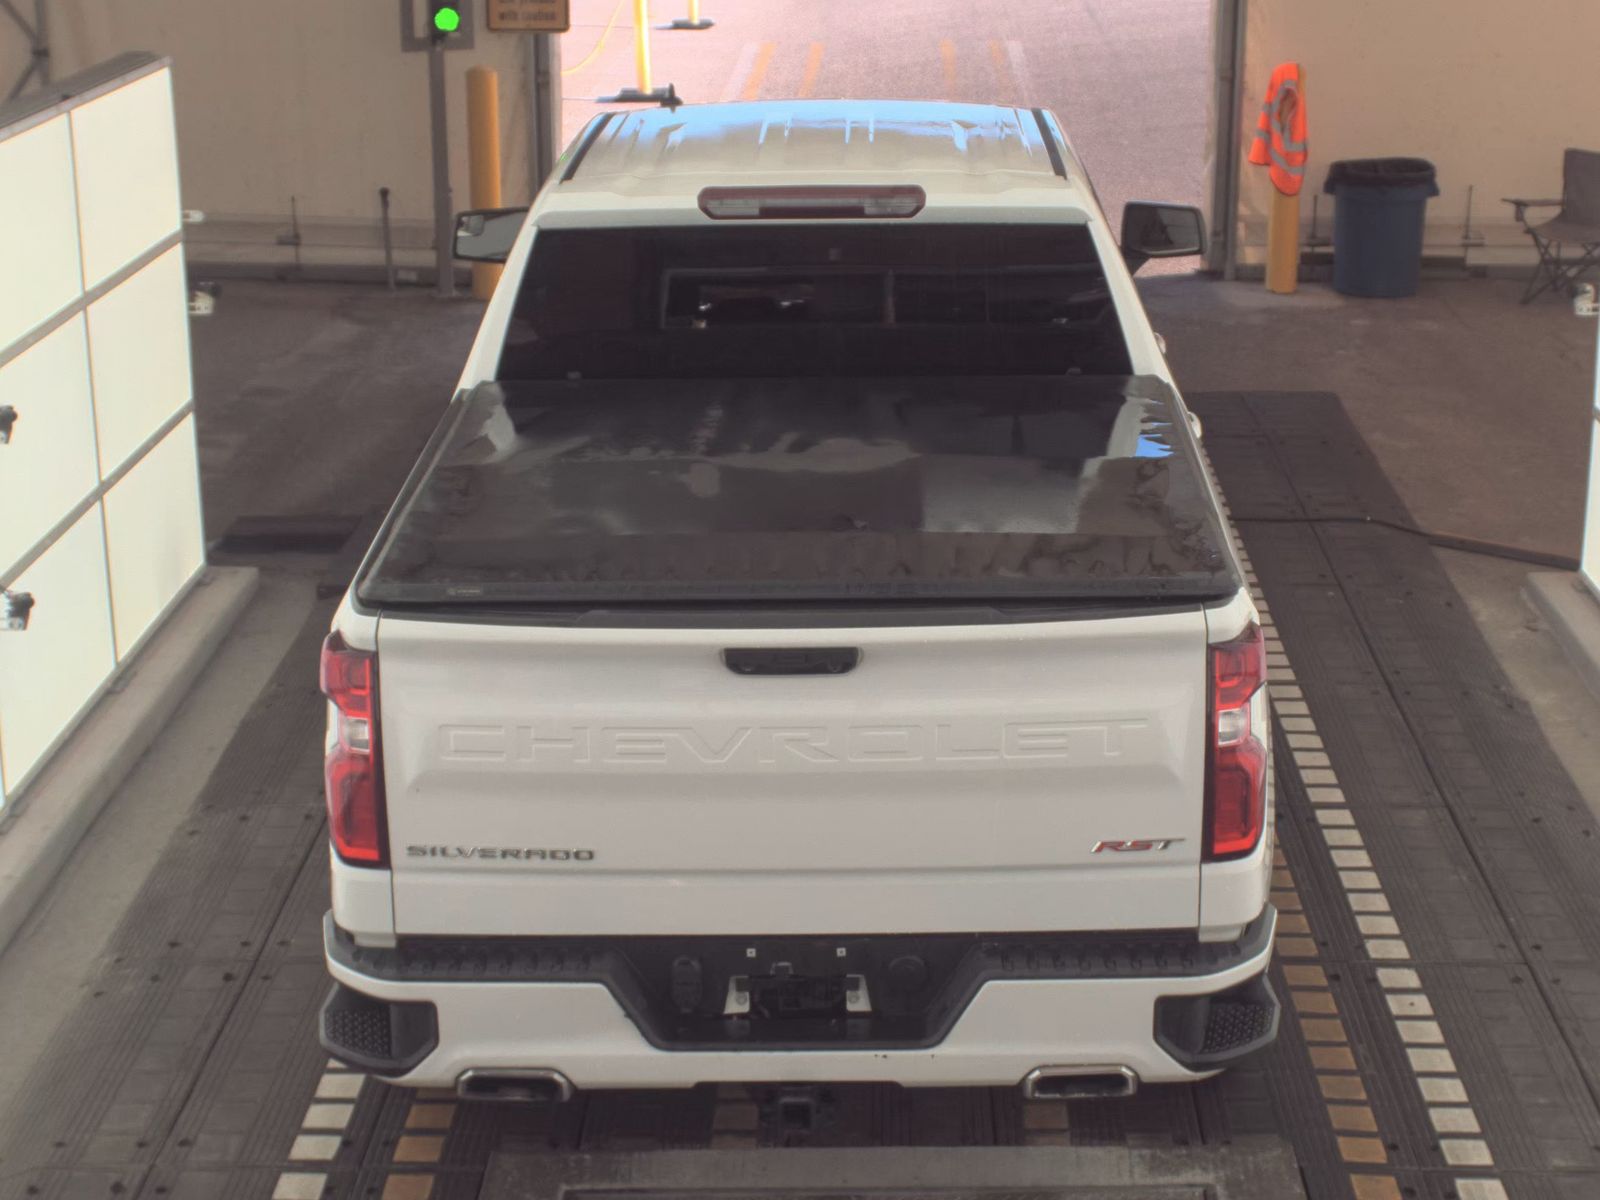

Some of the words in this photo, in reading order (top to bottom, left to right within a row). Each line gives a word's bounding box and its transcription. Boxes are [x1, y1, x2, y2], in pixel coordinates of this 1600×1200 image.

[438, 719, 1149, 764] CHEVROLET
[406, 845, 595, 861] SILVERADO
[1090, 837, 1185, 853] RST
